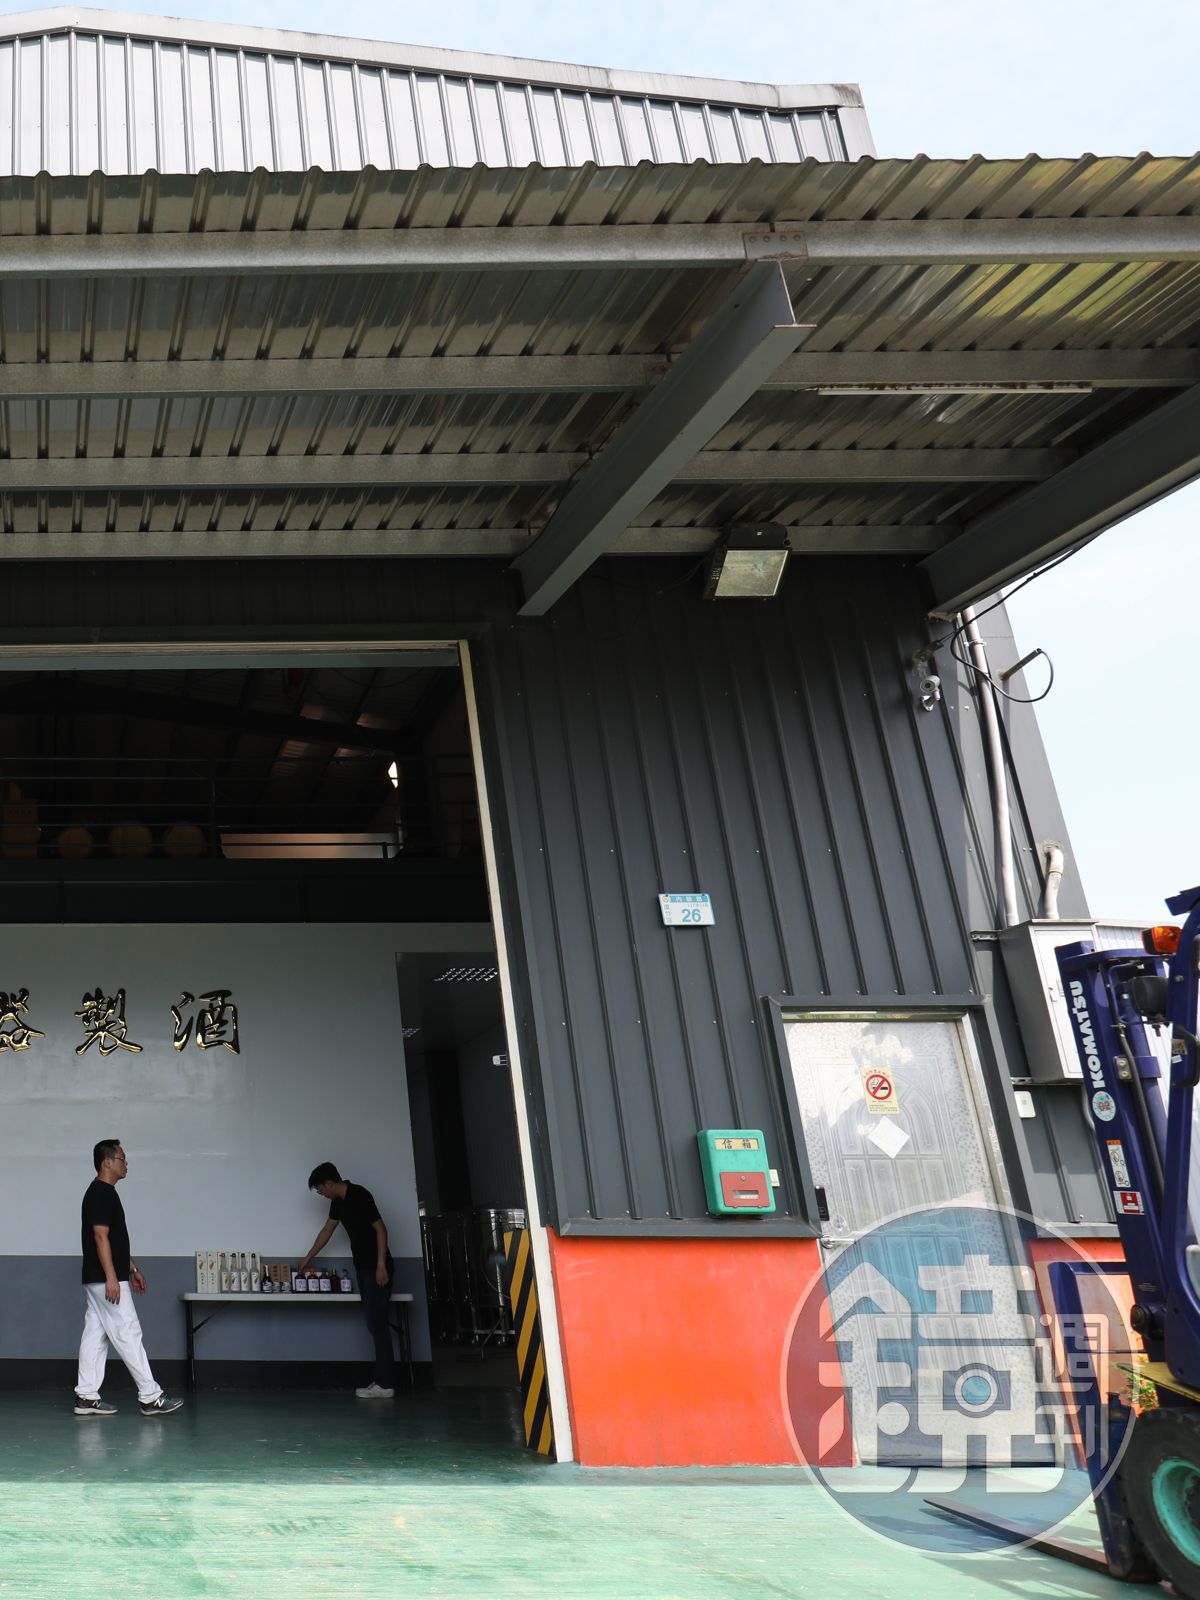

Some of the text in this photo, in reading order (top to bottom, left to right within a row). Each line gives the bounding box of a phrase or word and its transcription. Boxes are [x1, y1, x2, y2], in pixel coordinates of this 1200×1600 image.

[681, 908, 702, 923] 26
[1069, 980, 1106, 1089] KOMATSU
[722, 1139, 752, 1150] 信箱
